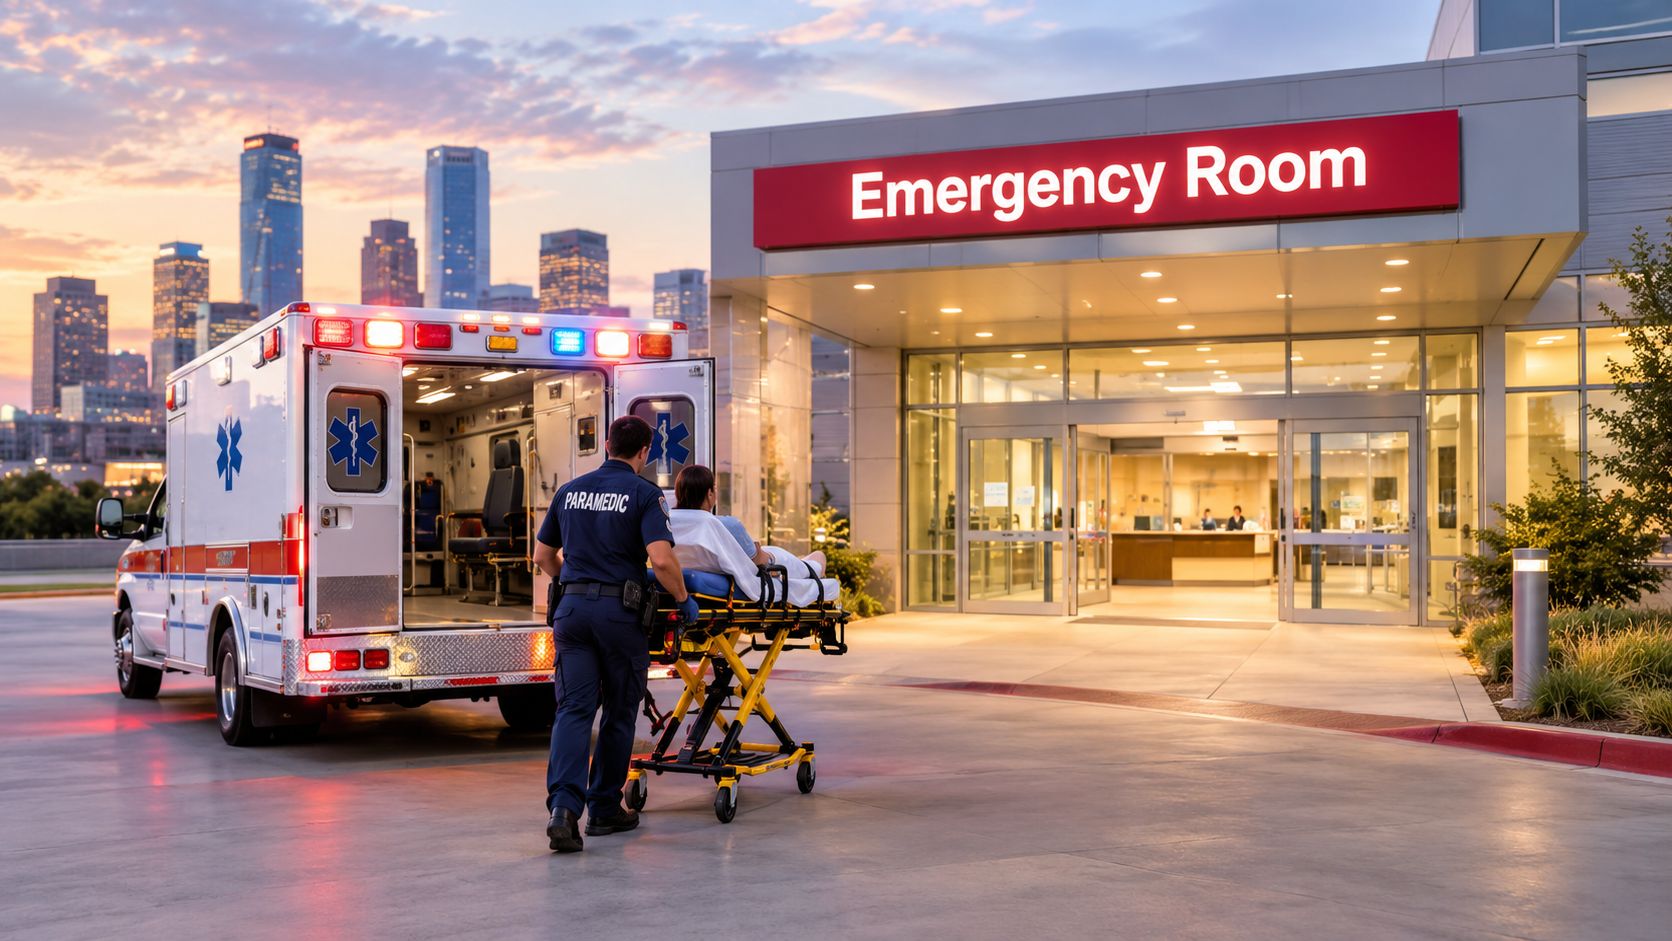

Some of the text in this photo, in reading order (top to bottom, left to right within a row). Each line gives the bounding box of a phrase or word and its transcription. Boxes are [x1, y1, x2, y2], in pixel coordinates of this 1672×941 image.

[851, 145, 1367, 222] Emergency Room
[564, 491, 629, 513] PARAMEDIC
